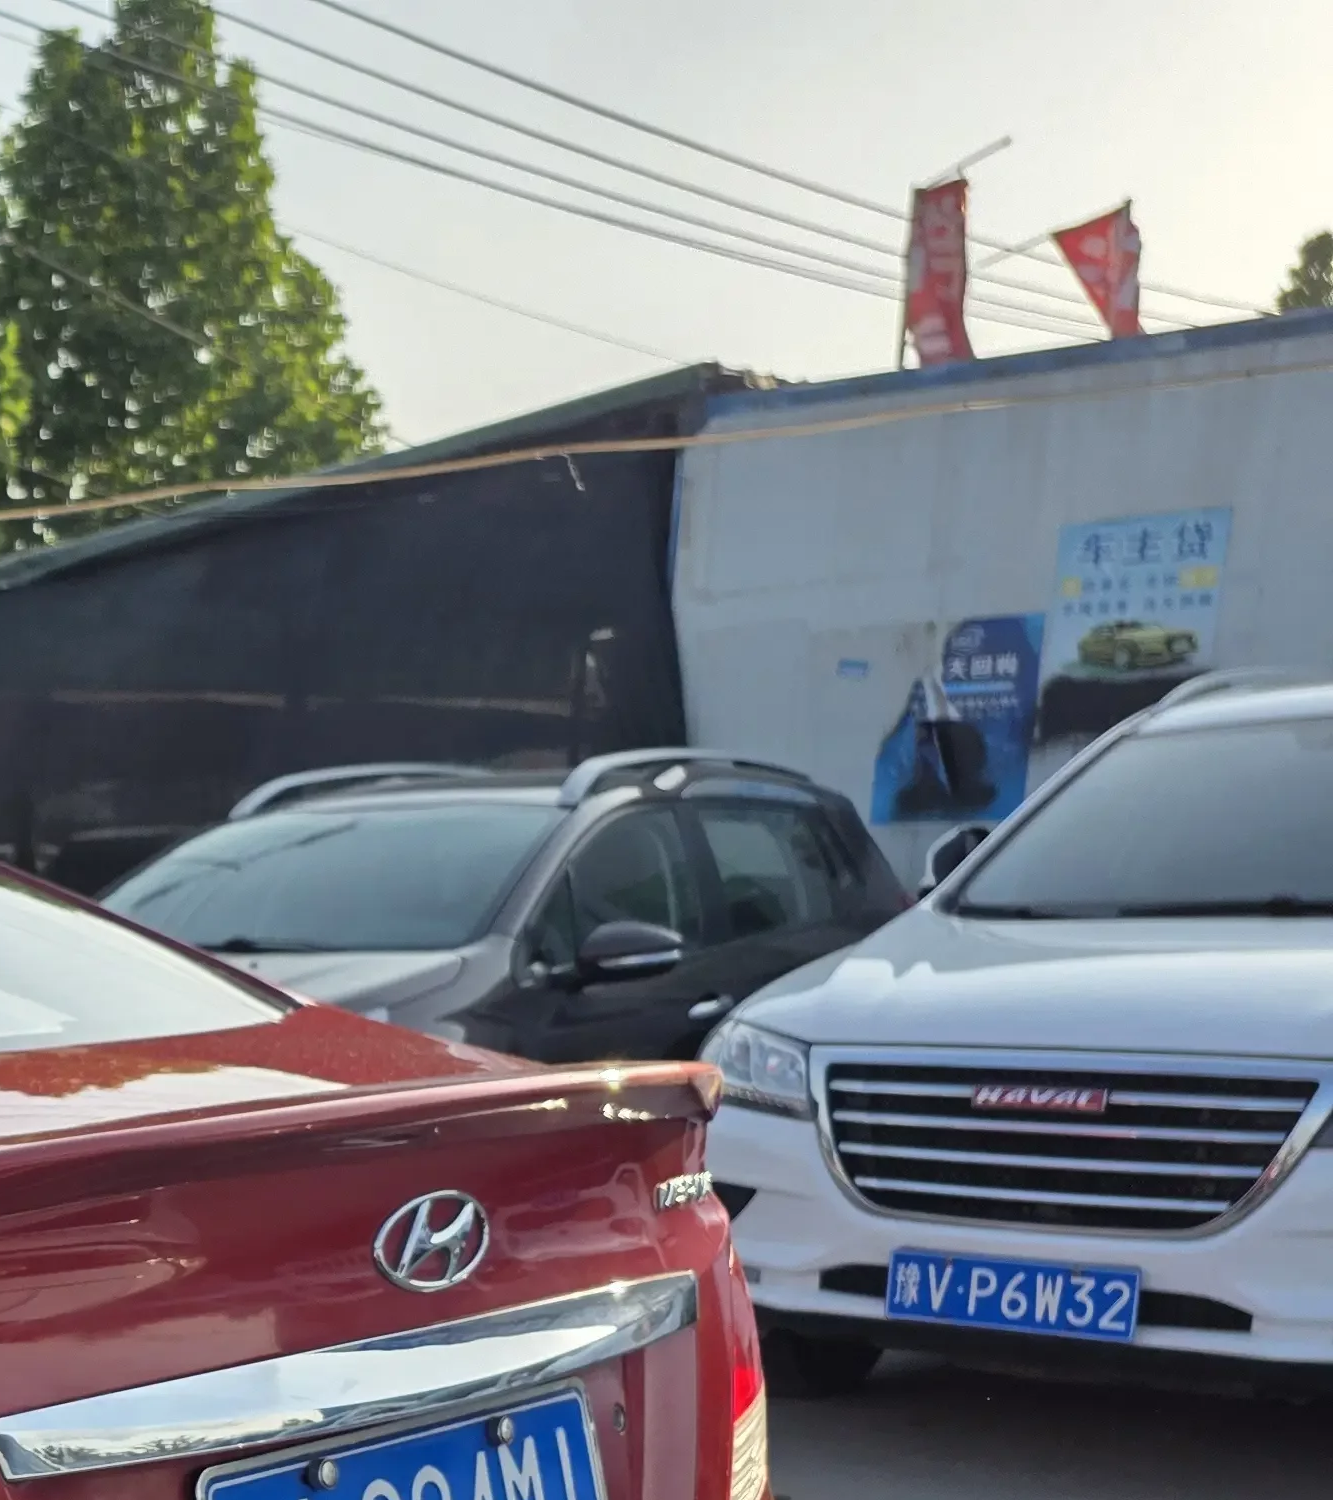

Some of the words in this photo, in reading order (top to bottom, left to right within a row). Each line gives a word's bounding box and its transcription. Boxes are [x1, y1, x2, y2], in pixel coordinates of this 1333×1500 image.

[1078, 520, 1213, 567] 车主贷
[976, 1087, 1097, 1109] HAVAL
